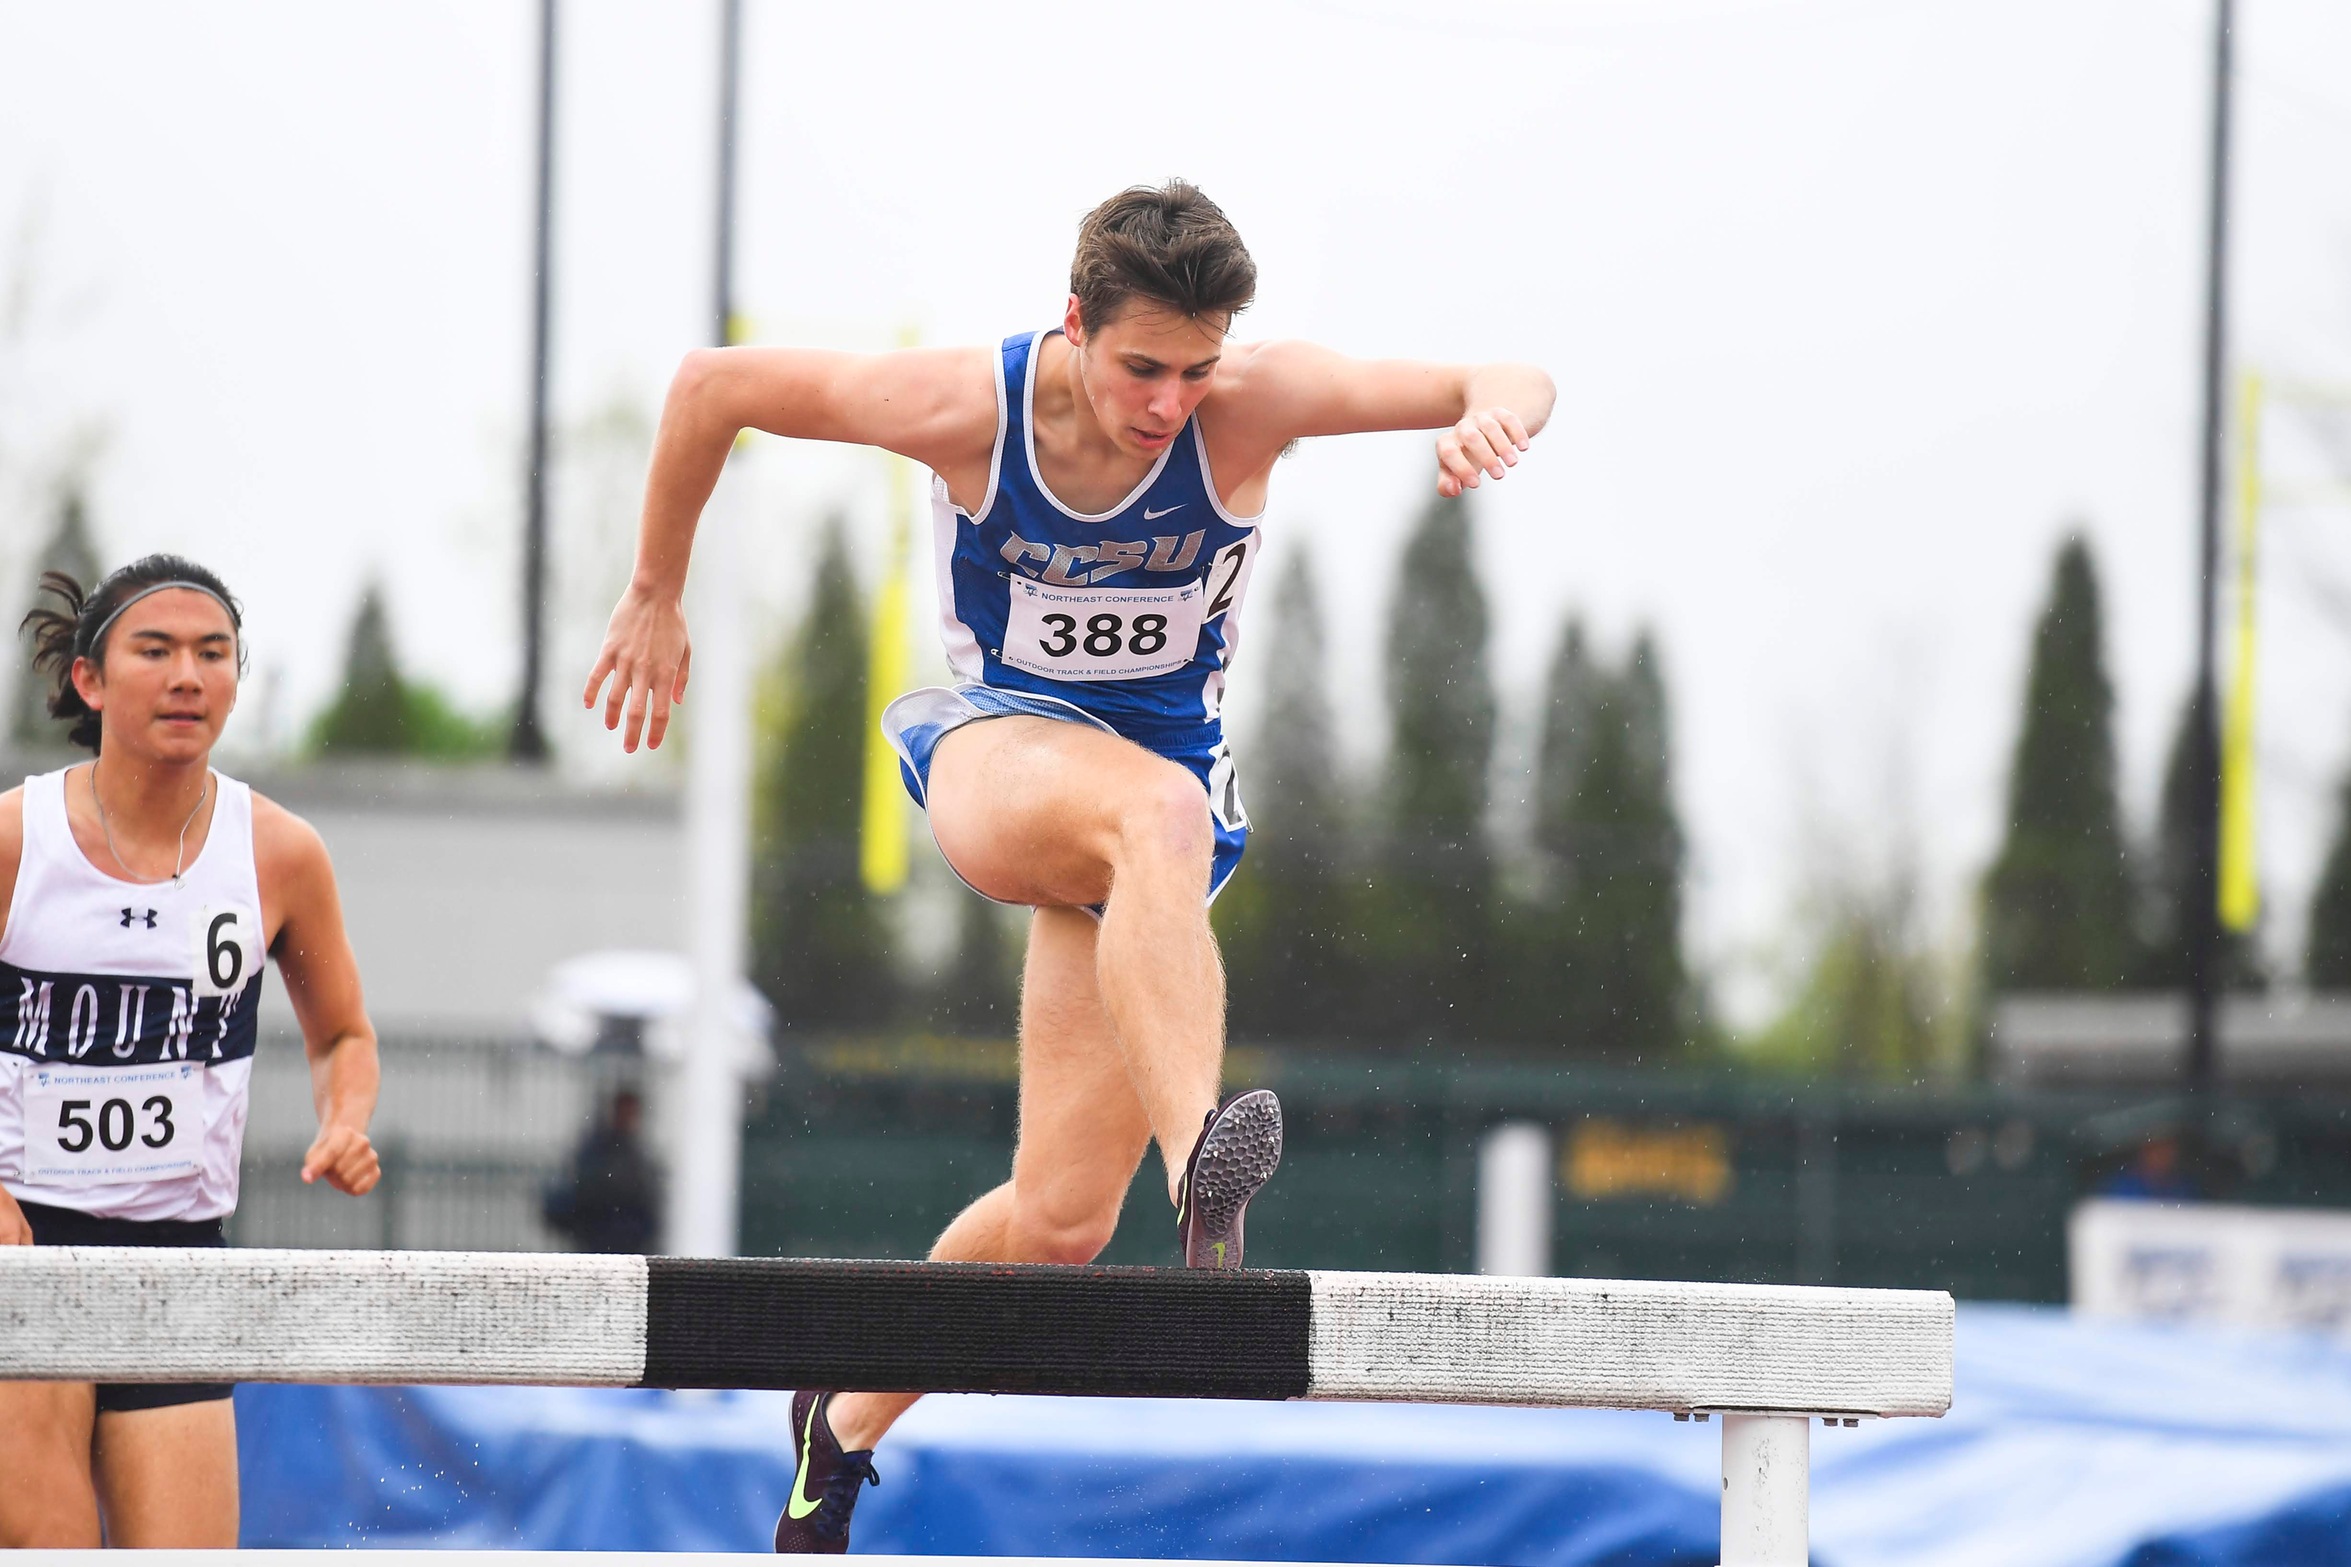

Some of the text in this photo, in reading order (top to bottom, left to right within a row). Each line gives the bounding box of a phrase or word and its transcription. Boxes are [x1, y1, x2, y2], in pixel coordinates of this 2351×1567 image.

[1000, 529, 1206, 586] CCSU
[1207, 542, 1247, 618] 2
[1041, 592, 1174, 603] NORTHEAST CONFERENCE
[1039, 613, 1168, 657] 388
[1016, 658, 1055, 674] OUTDOOR
[1118, 659, 1183, 674] CHAMPIONSHIPS
[206, 912, 243, 989] 6
[54, 1071, 176, 1085] NORTHEAST CONFERENCE
[57, 1095, 175, 1152] 503
